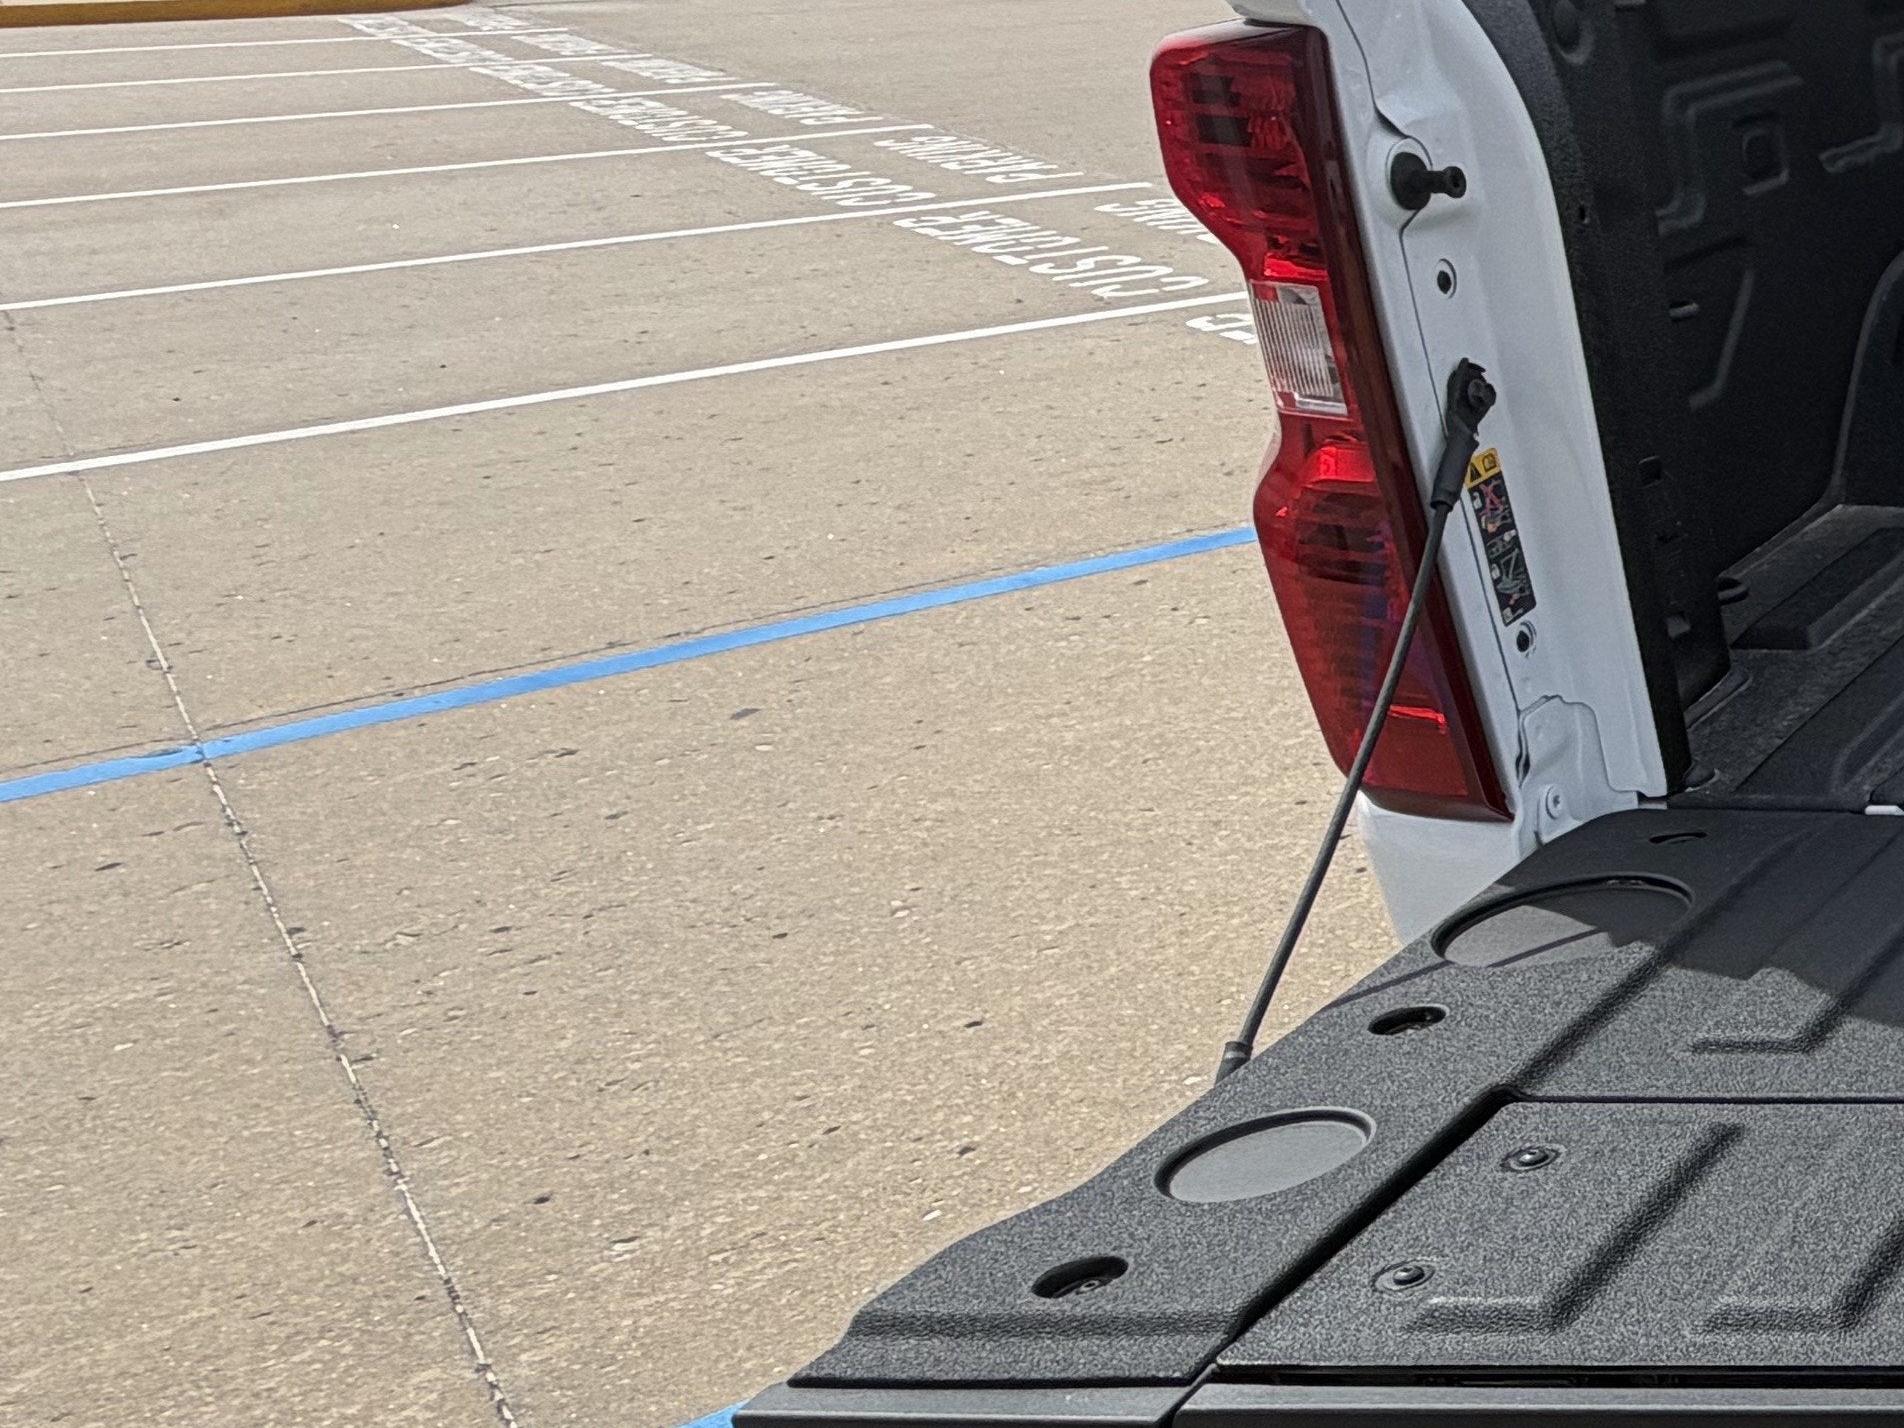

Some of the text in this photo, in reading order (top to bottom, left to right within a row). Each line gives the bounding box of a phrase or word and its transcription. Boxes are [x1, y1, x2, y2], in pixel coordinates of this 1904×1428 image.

[705, 144, 936, 207] CUSTOMER
[873, 135, 1085, 183] PARKING
[893, 210, 1209, 298] CUSTOMER
